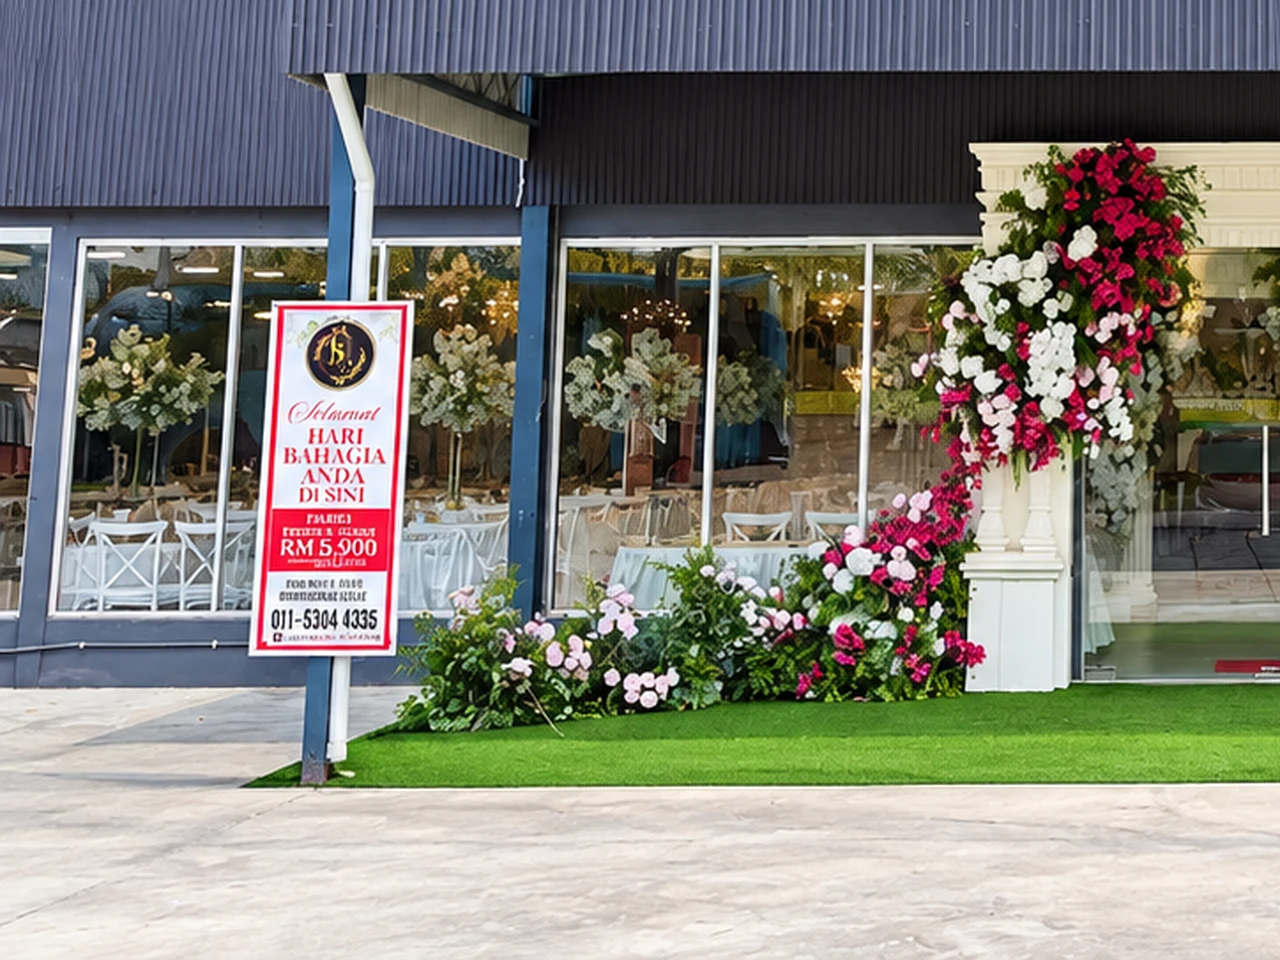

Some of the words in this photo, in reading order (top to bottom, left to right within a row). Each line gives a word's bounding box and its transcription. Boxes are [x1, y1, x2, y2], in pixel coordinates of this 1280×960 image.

[308, 428, 363, 444] HARI
[283, 447, 386, 464] BAHAGIA
[301, 468, 365, 484] ANDA
[299, 487, 318, 503] DI
[325, 487, 364, 503] SINI
[280, 539, 314, 556] RM
[271, 609, 338, 630] 011-5304
[342, 609, 377, 630] 4335
